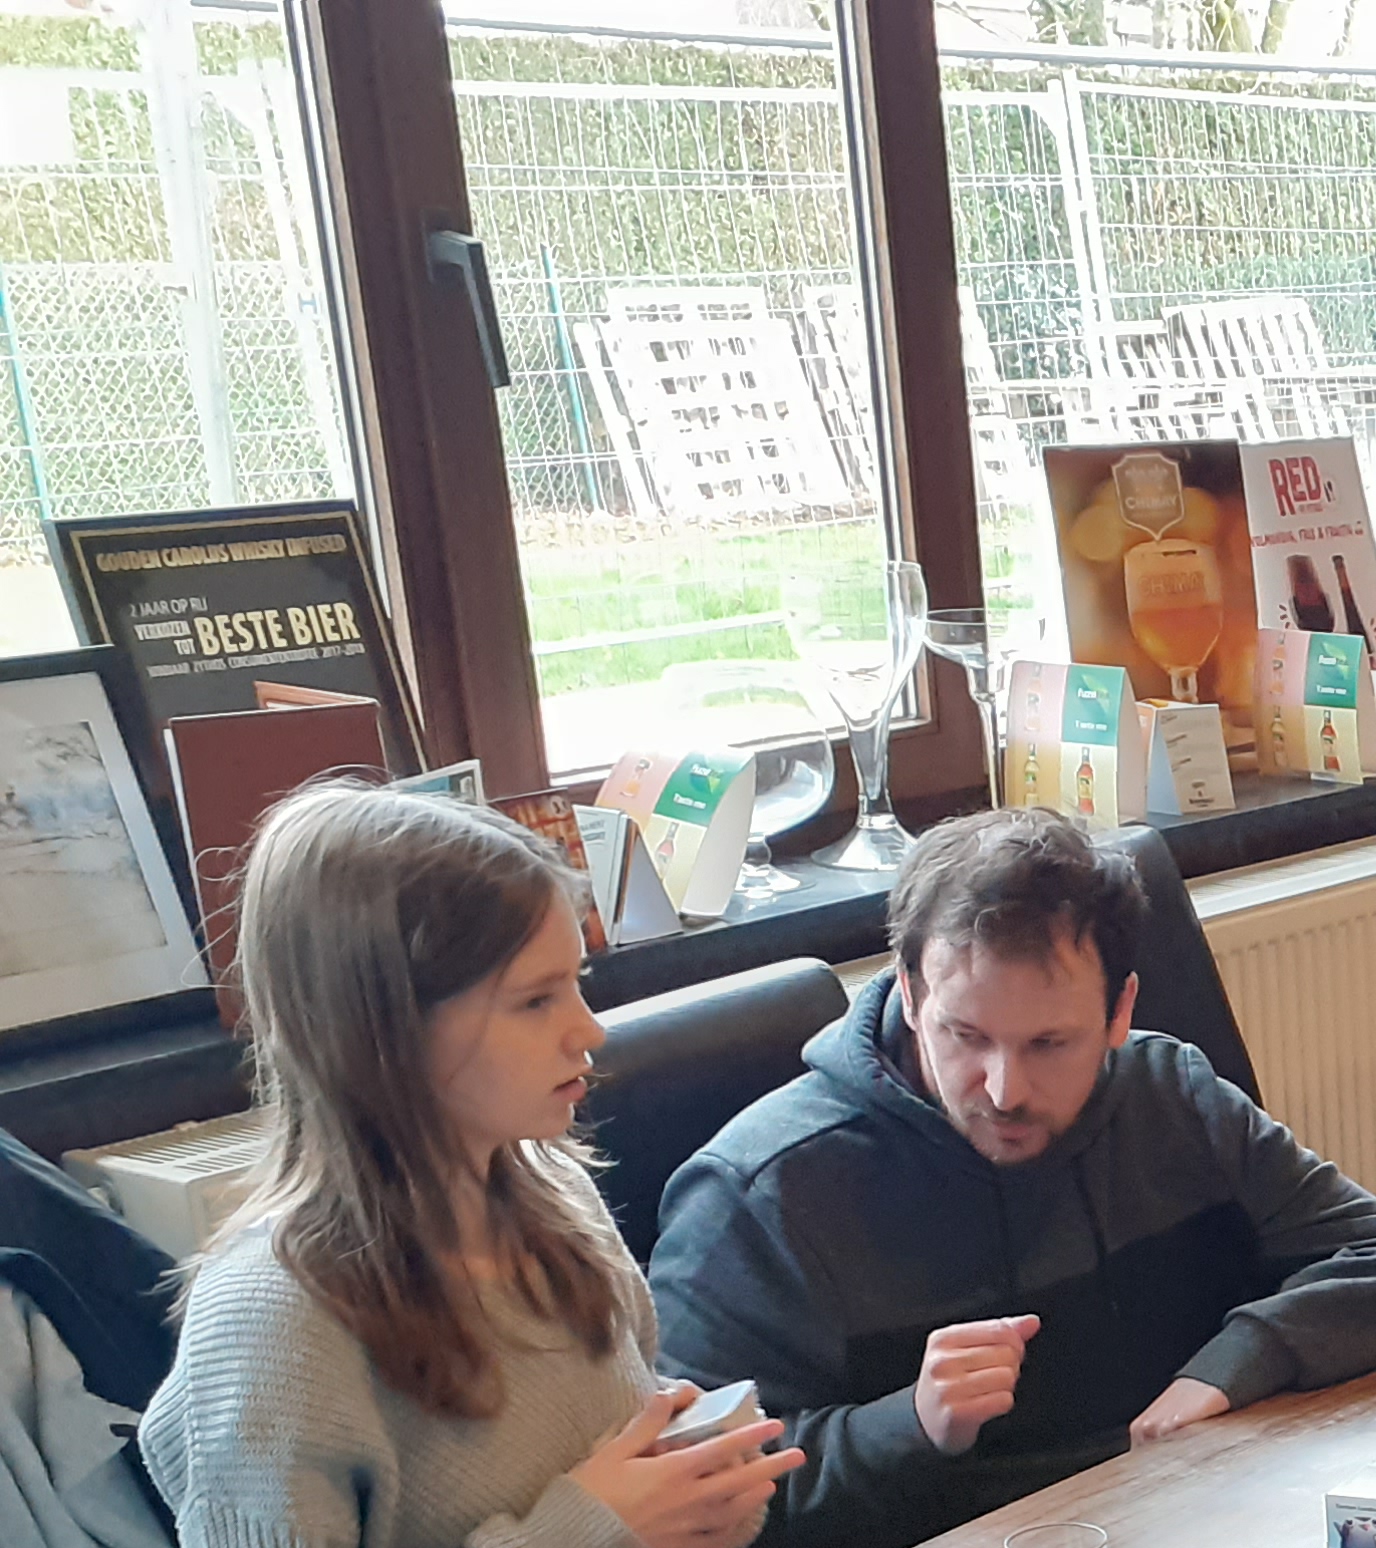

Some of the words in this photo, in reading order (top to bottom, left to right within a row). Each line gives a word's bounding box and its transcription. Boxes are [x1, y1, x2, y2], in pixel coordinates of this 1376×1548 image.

[1267, 456, 1322, 516] RED
[139, 601, 170, 616] JAAR
[171, 599, 190, 613] OP
[194, 609, 288, 656] BESTE
[287, 602, 361, 646] BIER
[174, 639, 196, 655] TOT
